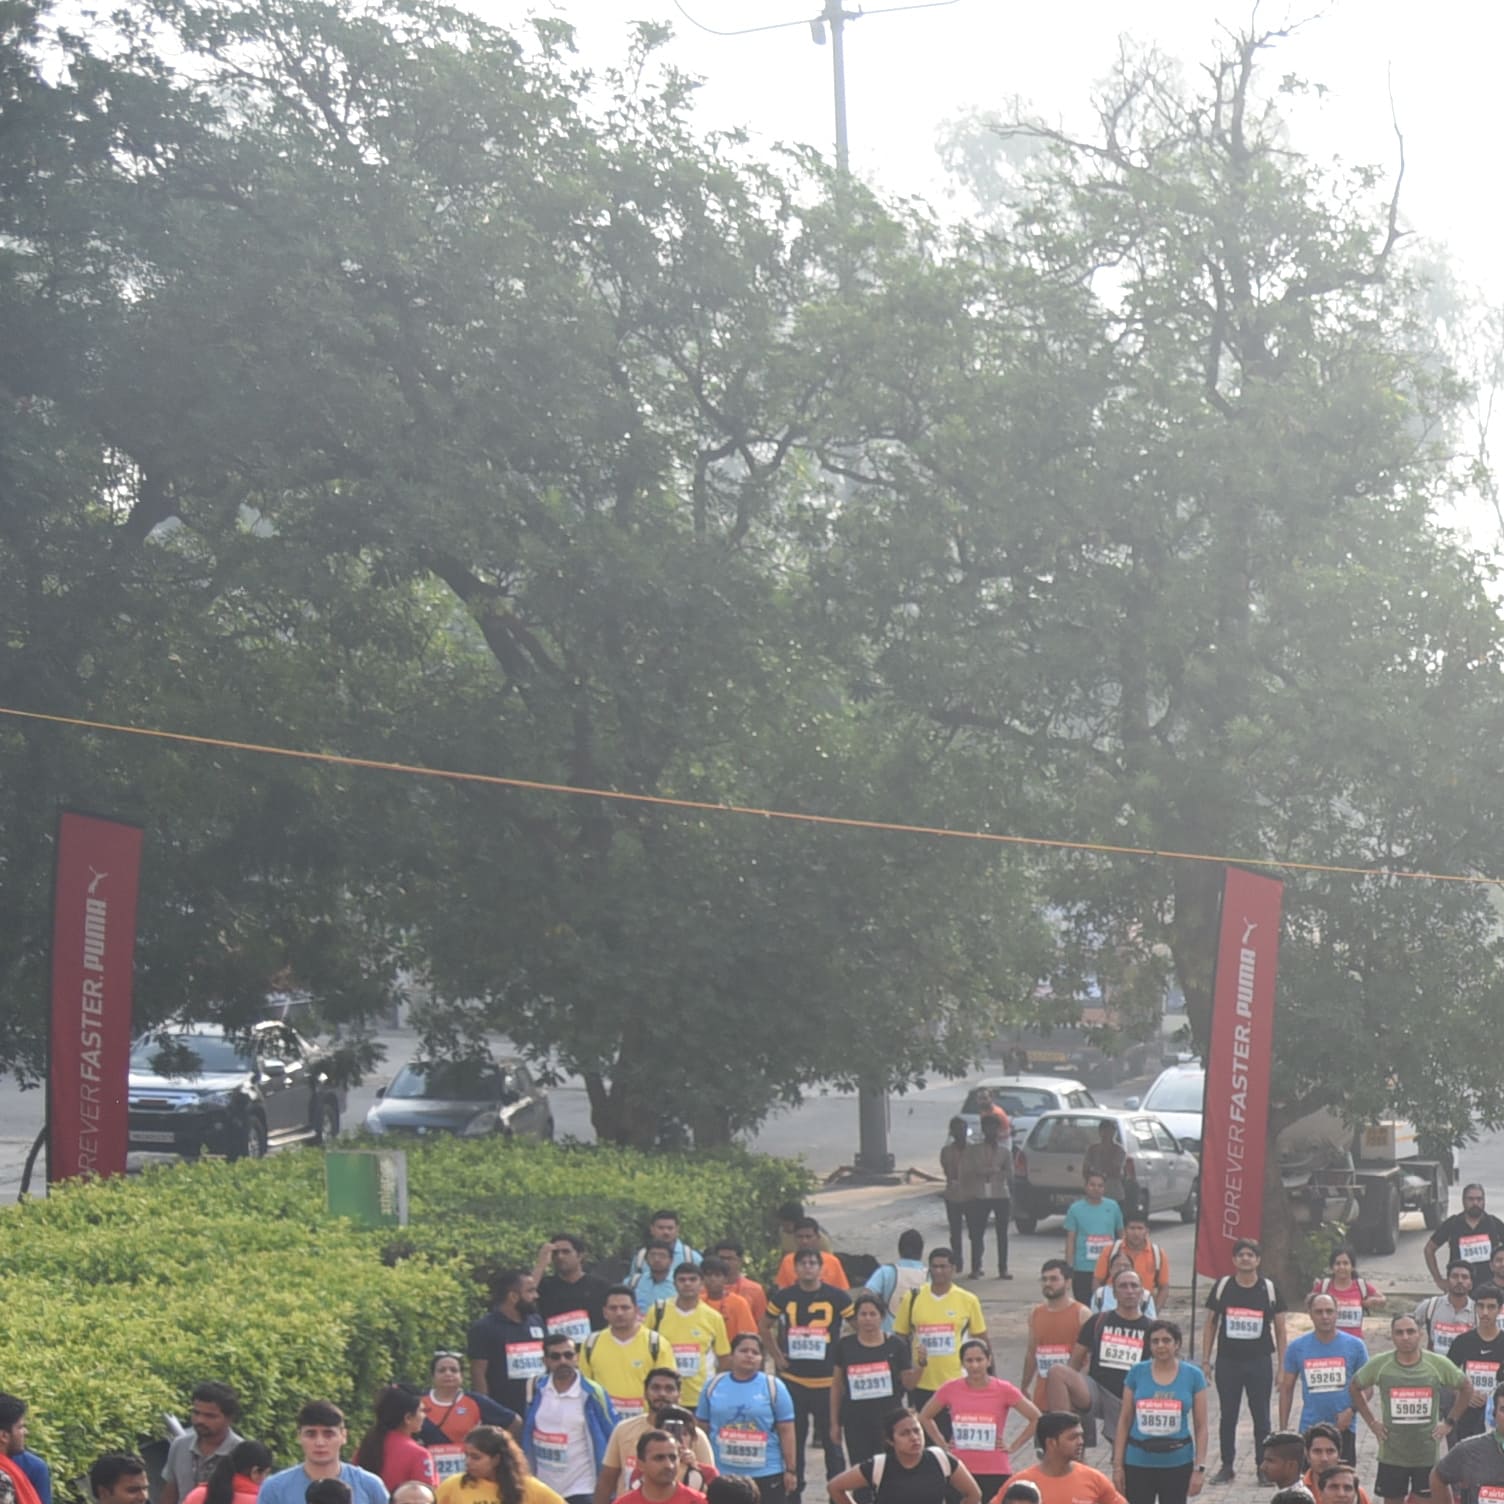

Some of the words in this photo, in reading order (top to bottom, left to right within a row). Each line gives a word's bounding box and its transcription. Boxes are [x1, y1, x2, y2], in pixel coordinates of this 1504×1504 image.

[83, 898, 107, 972] PUMA
[1222, 1124, 1246, 1241] FOREVER
[1236, 947, 1256, 1019] PUMA
[1310, 1371, 1342, 1383] 59263
[1396, 1403, 1428, 1415] 59025
